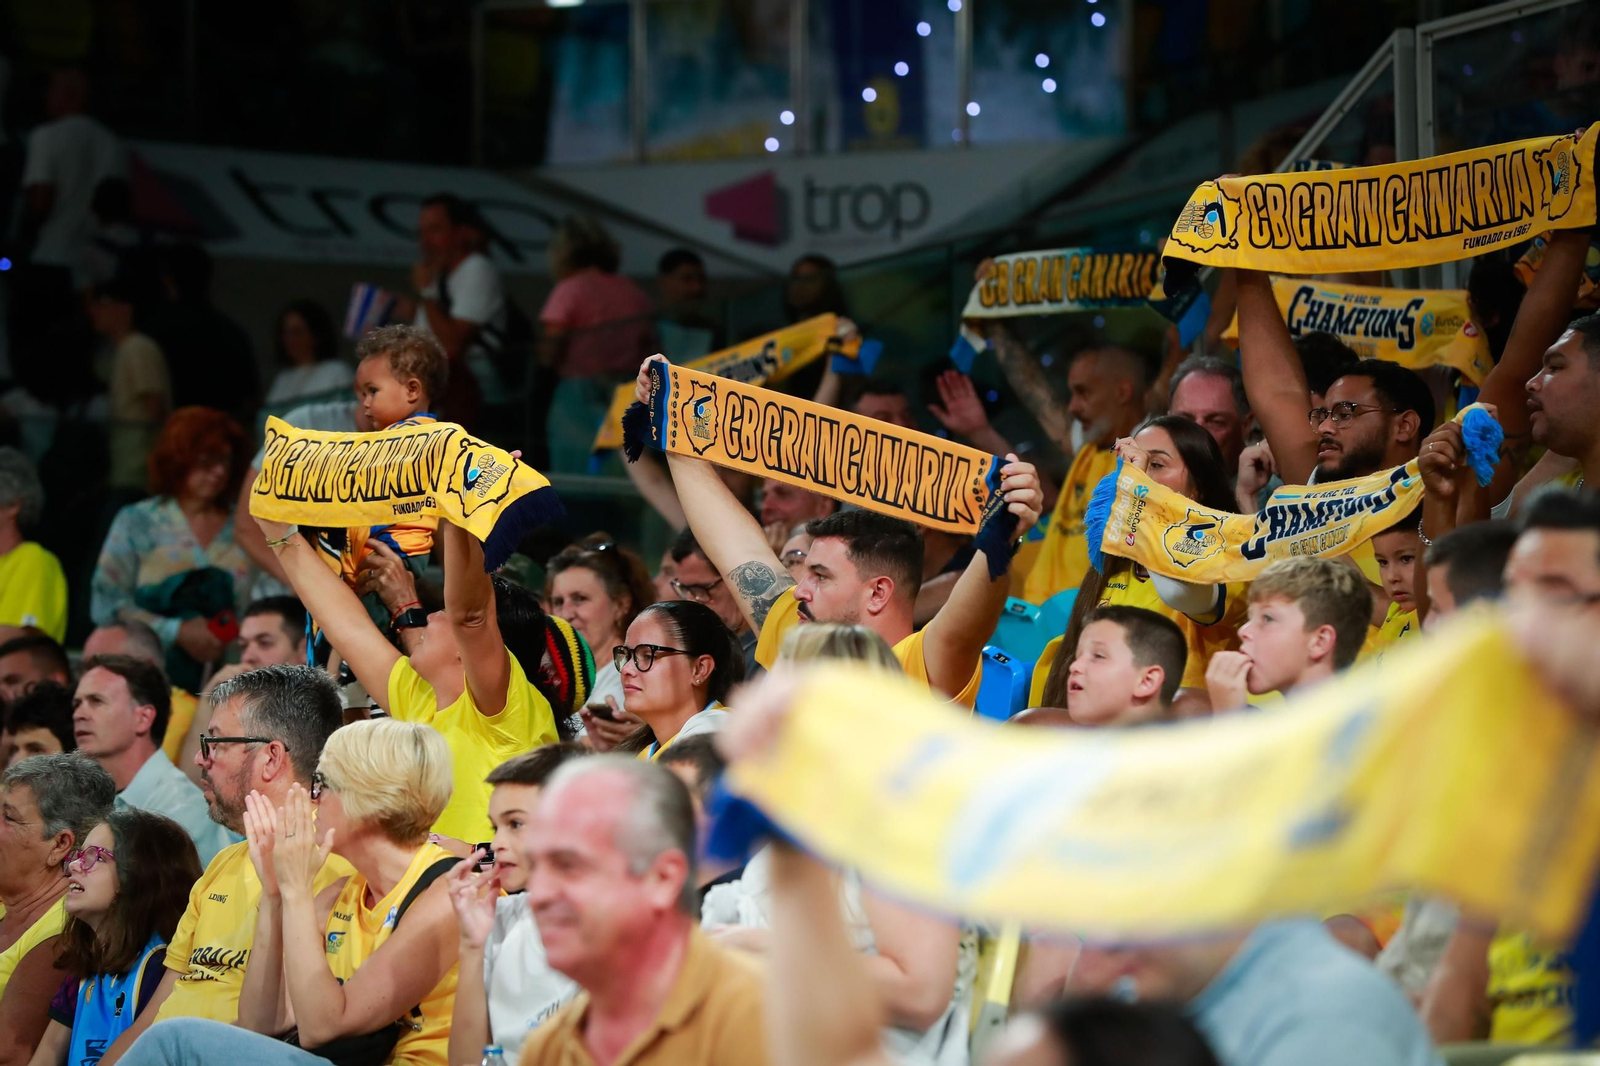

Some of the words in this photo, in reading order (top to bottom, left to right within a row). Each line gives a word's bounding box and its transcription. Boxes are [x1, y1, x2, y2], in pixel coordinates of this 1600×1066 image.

[803, 174, 932, 241] trop
[1462, 230, 1504, 250] FUNDADO
[980, 261, 1010, 308] CB
[1012, 255, 1067, 305] GRAN
[1066, 252, 1158, 301] CANARIA
[1287, 285, 1426, 351] CHAMPIONS
[1130, 499, 1147, 533] EuroCup
